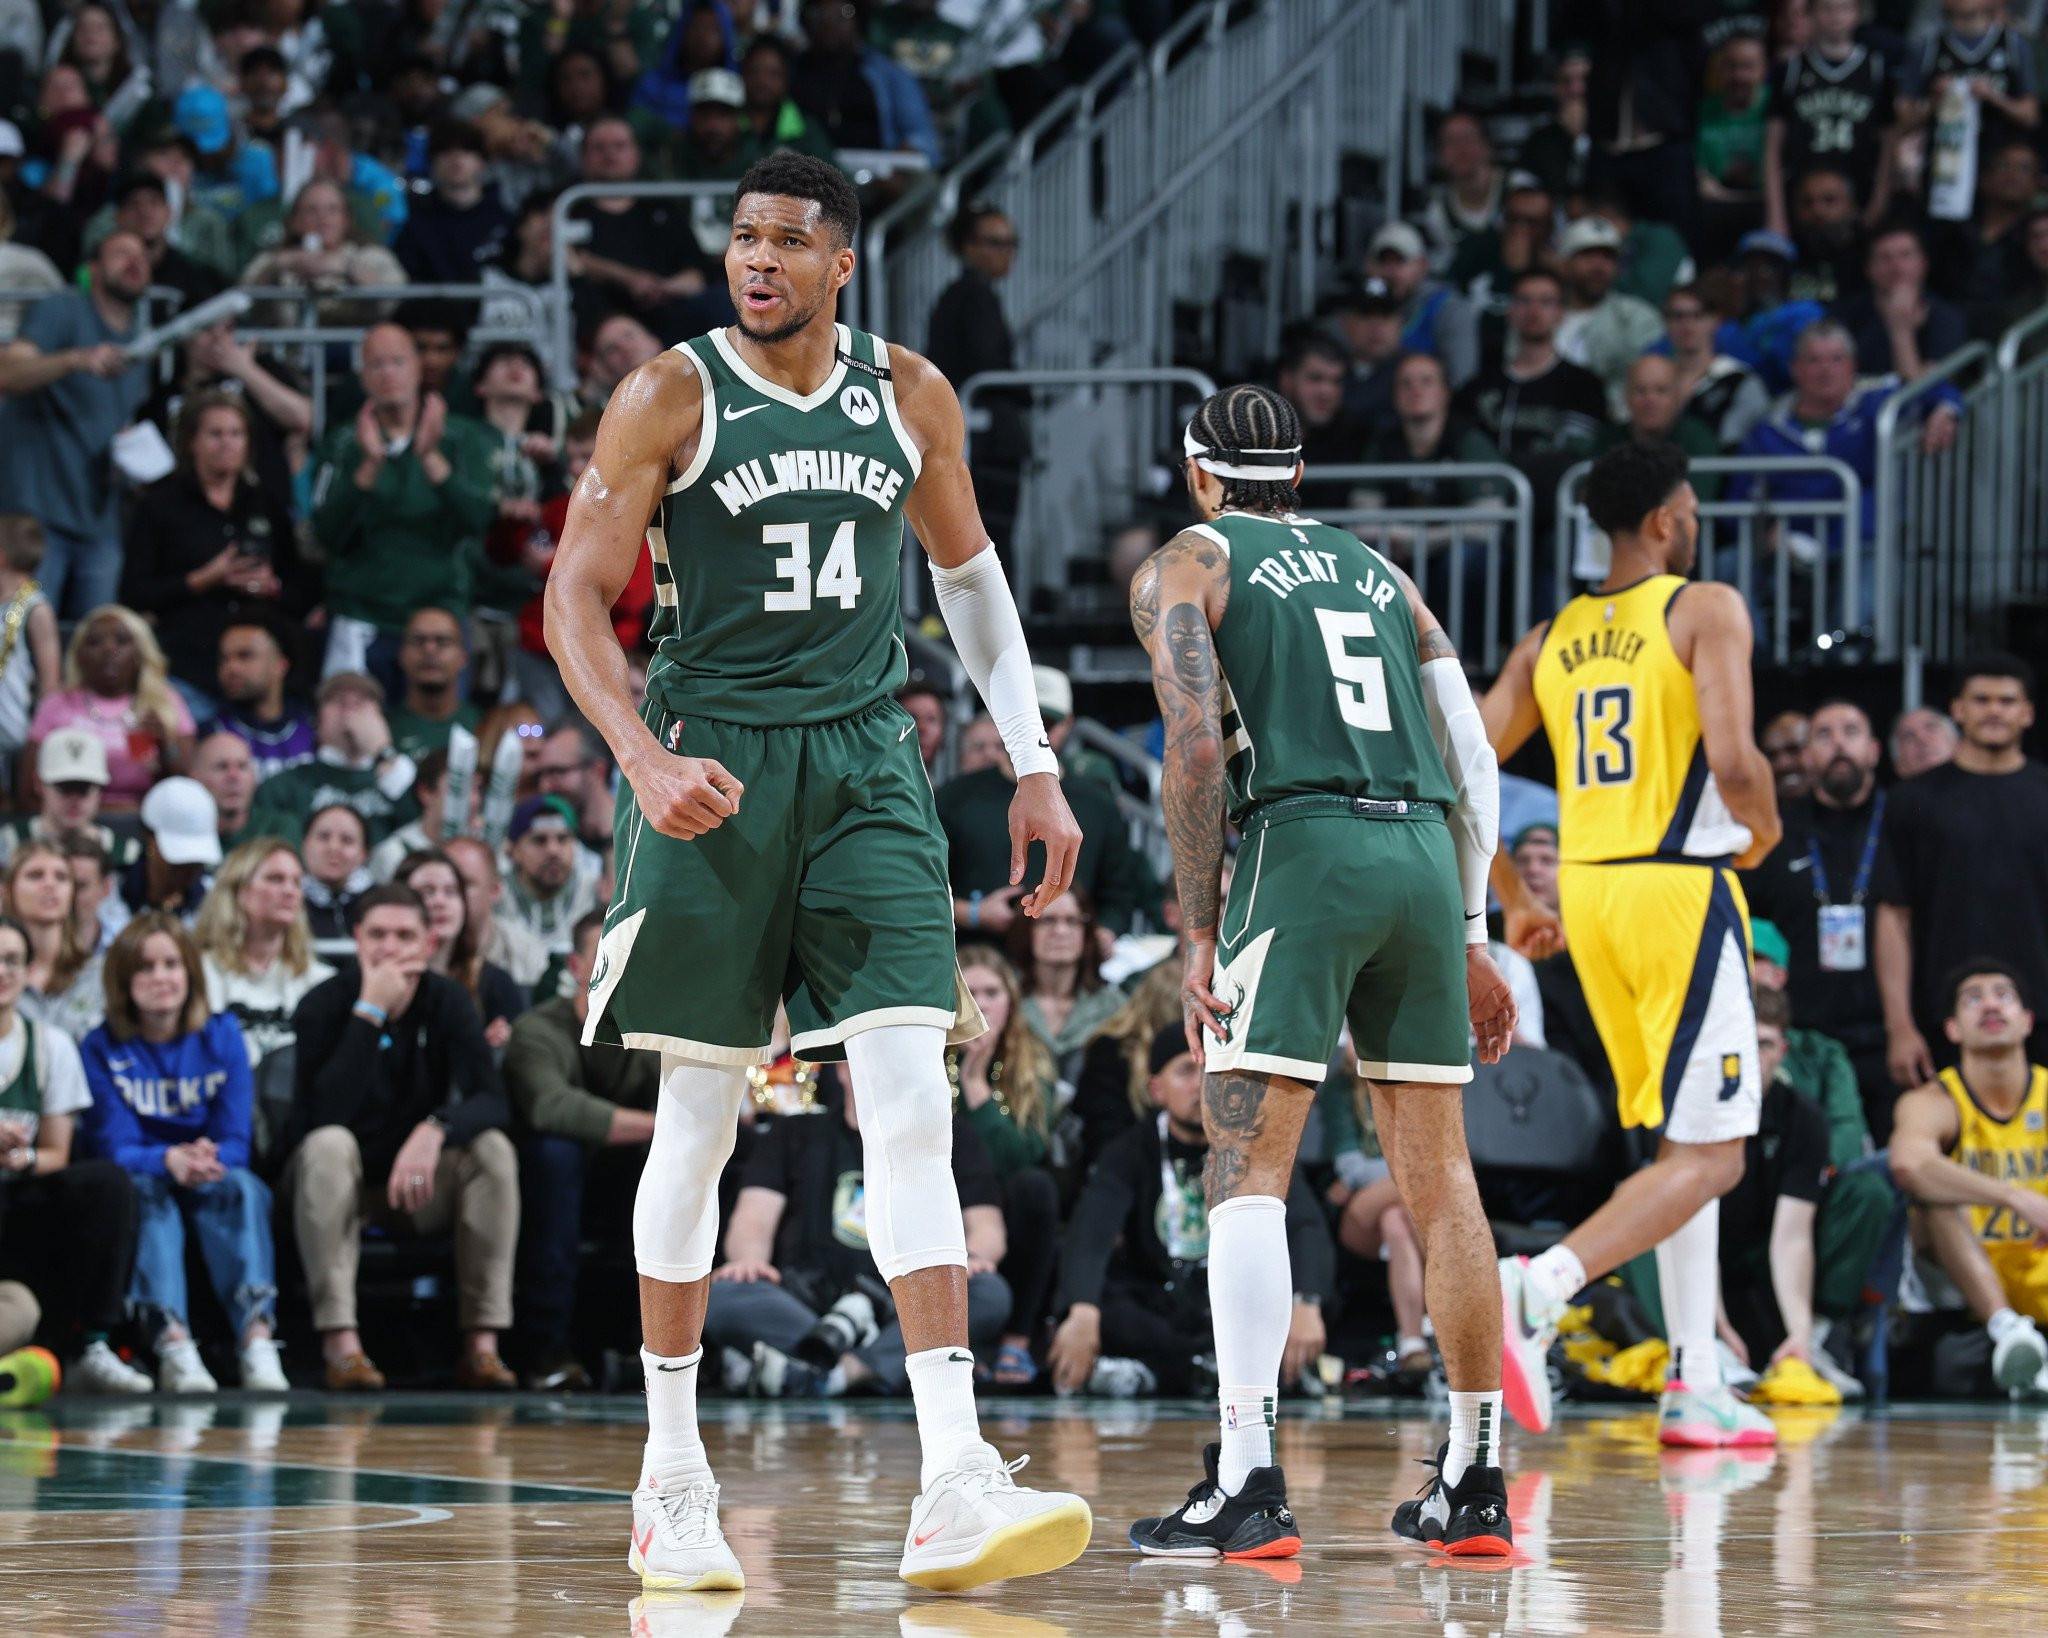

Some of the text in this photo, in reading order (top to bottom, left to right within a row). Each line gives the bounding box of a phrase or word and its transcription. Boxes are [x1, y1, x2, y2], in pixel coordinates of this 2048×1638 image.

[843, 355, 885, 378] BRIDGEMAN
[711, 450, 904, 516] MILWAUKEE
[763, 521, 862, 611] 34
[1248, 549, 1396, 613] TRENT JR
[1314, 607, 1392, 732] 5
[1559, 628, 1646, 674] BRADLEY
[1575, 685, 1634, 788] 13
